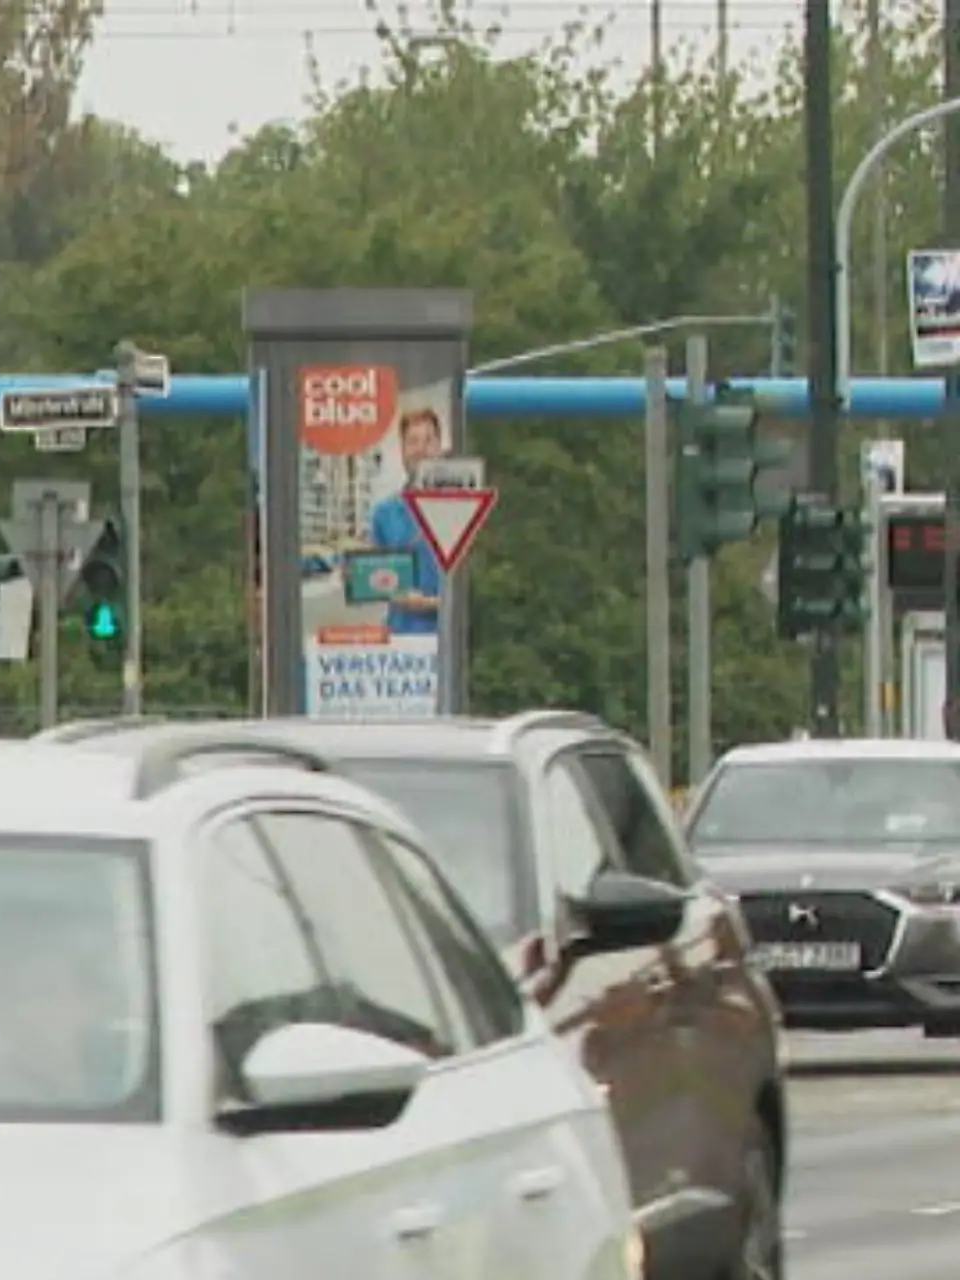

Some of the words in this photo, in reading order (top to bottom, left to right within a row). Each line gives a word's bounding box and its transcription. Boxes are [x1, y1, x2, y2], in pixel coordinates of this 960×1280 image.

[305, 369, 377, 398] cool
[305, 398, 377, 426] blue
[320, 680, 365, 699] DAS
[374, 678, 432, 698] TEAM
